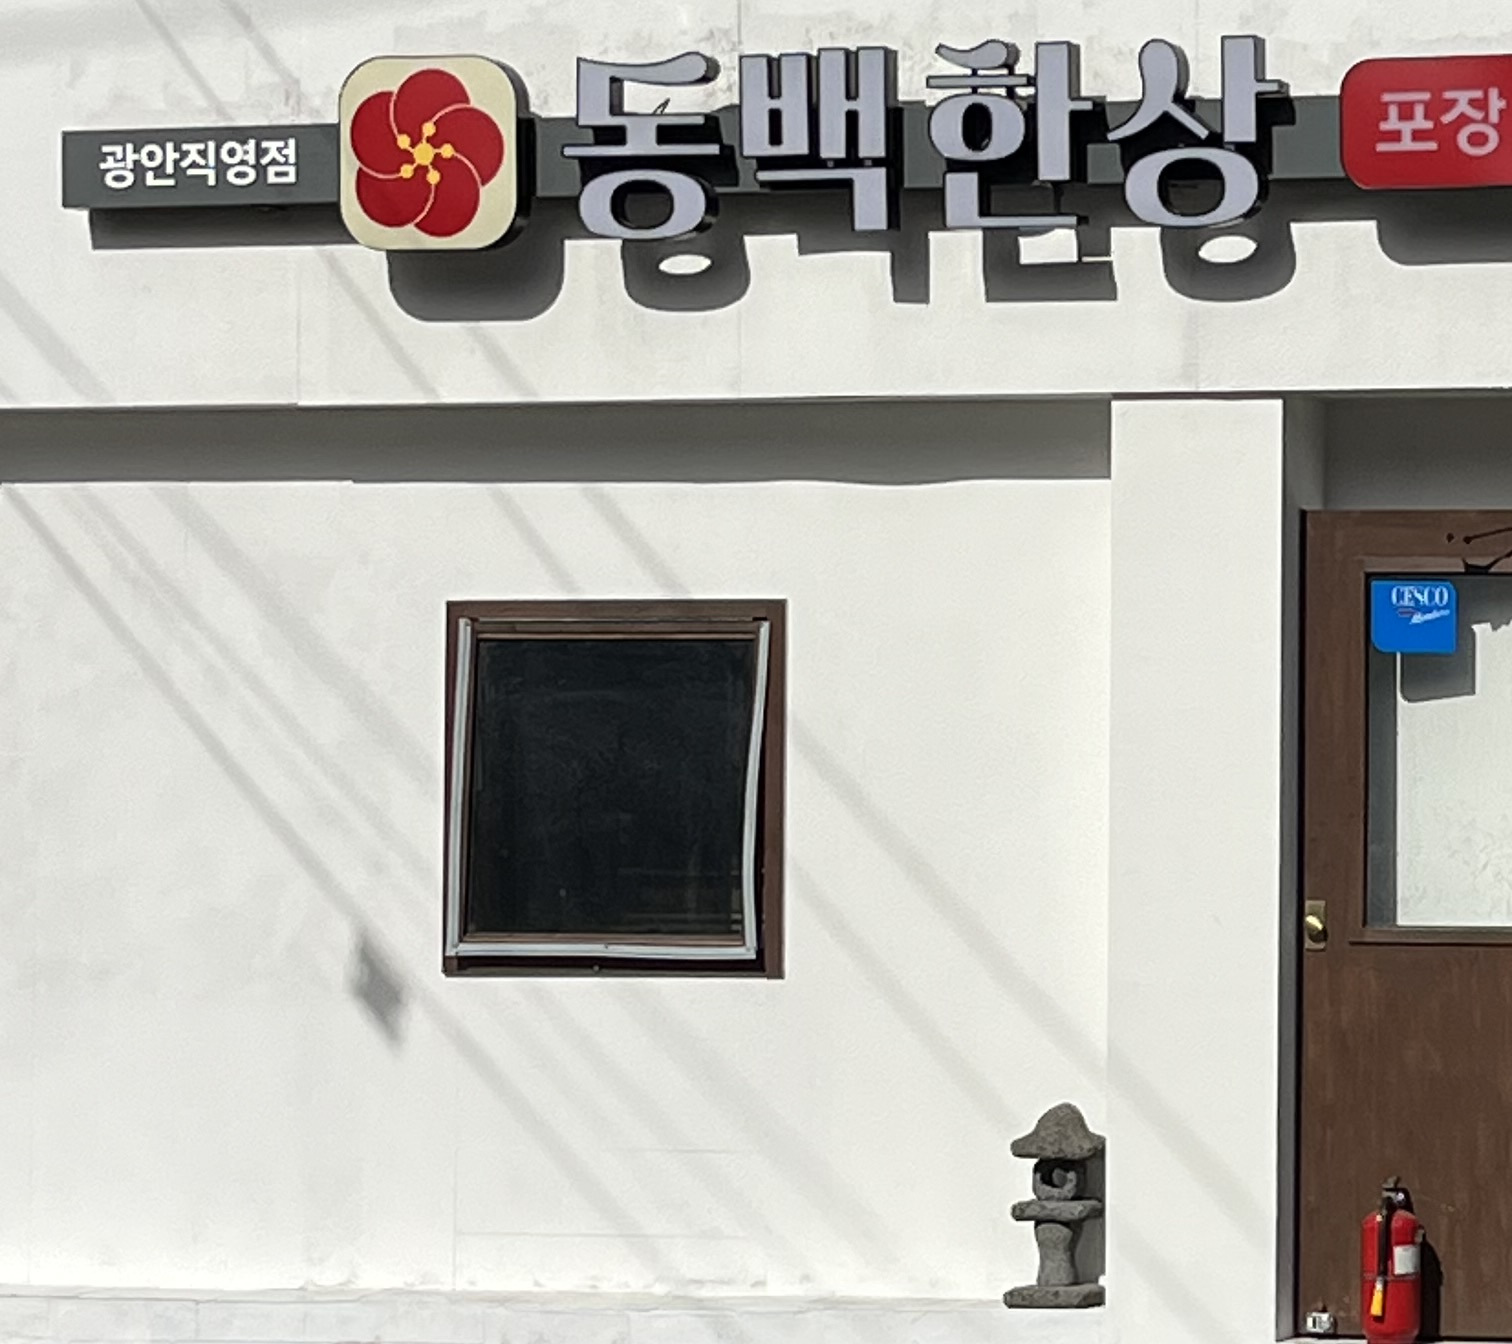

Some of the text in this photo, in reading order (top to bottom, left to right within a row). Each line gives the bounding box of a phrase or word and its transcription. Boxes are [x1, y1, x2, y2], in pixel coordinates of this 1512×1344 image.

[100, 138, 297, 189] 광안직영점
[563, 35, 1272, 241] 동백한상
[1390, 585, 1449, 607] CESCO
